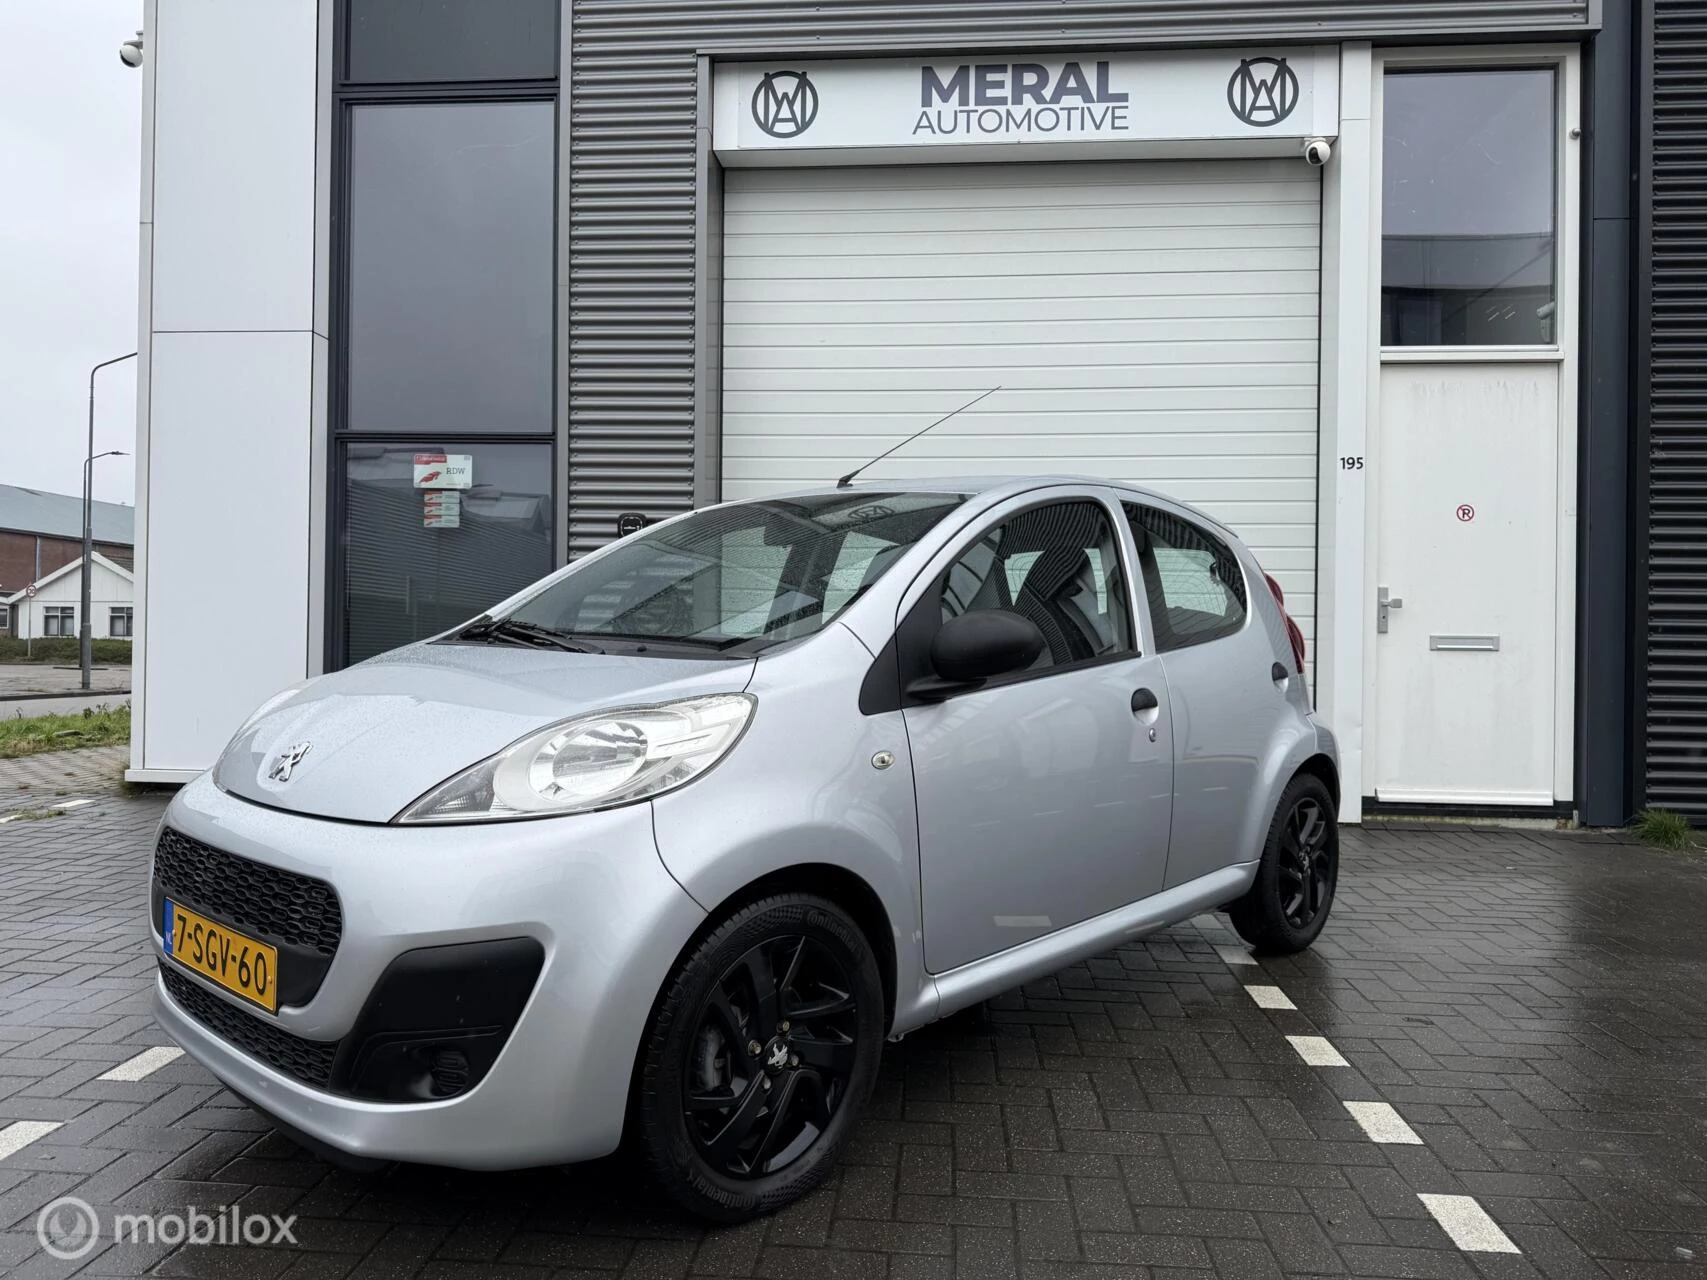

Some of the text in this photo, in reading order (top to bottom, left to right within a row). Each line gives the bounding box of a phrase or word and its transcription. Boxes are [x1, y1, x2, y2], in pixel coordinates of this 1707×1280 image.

[920, 61, 1129, 108] MERAL
[912, 105, 1129, 135] AUTOMOTIVE
[446, 467, 466, 475] RDW
[1340, 456, 1364, 470] 195
[177, 913, 267, 996] 7-SGV-60
